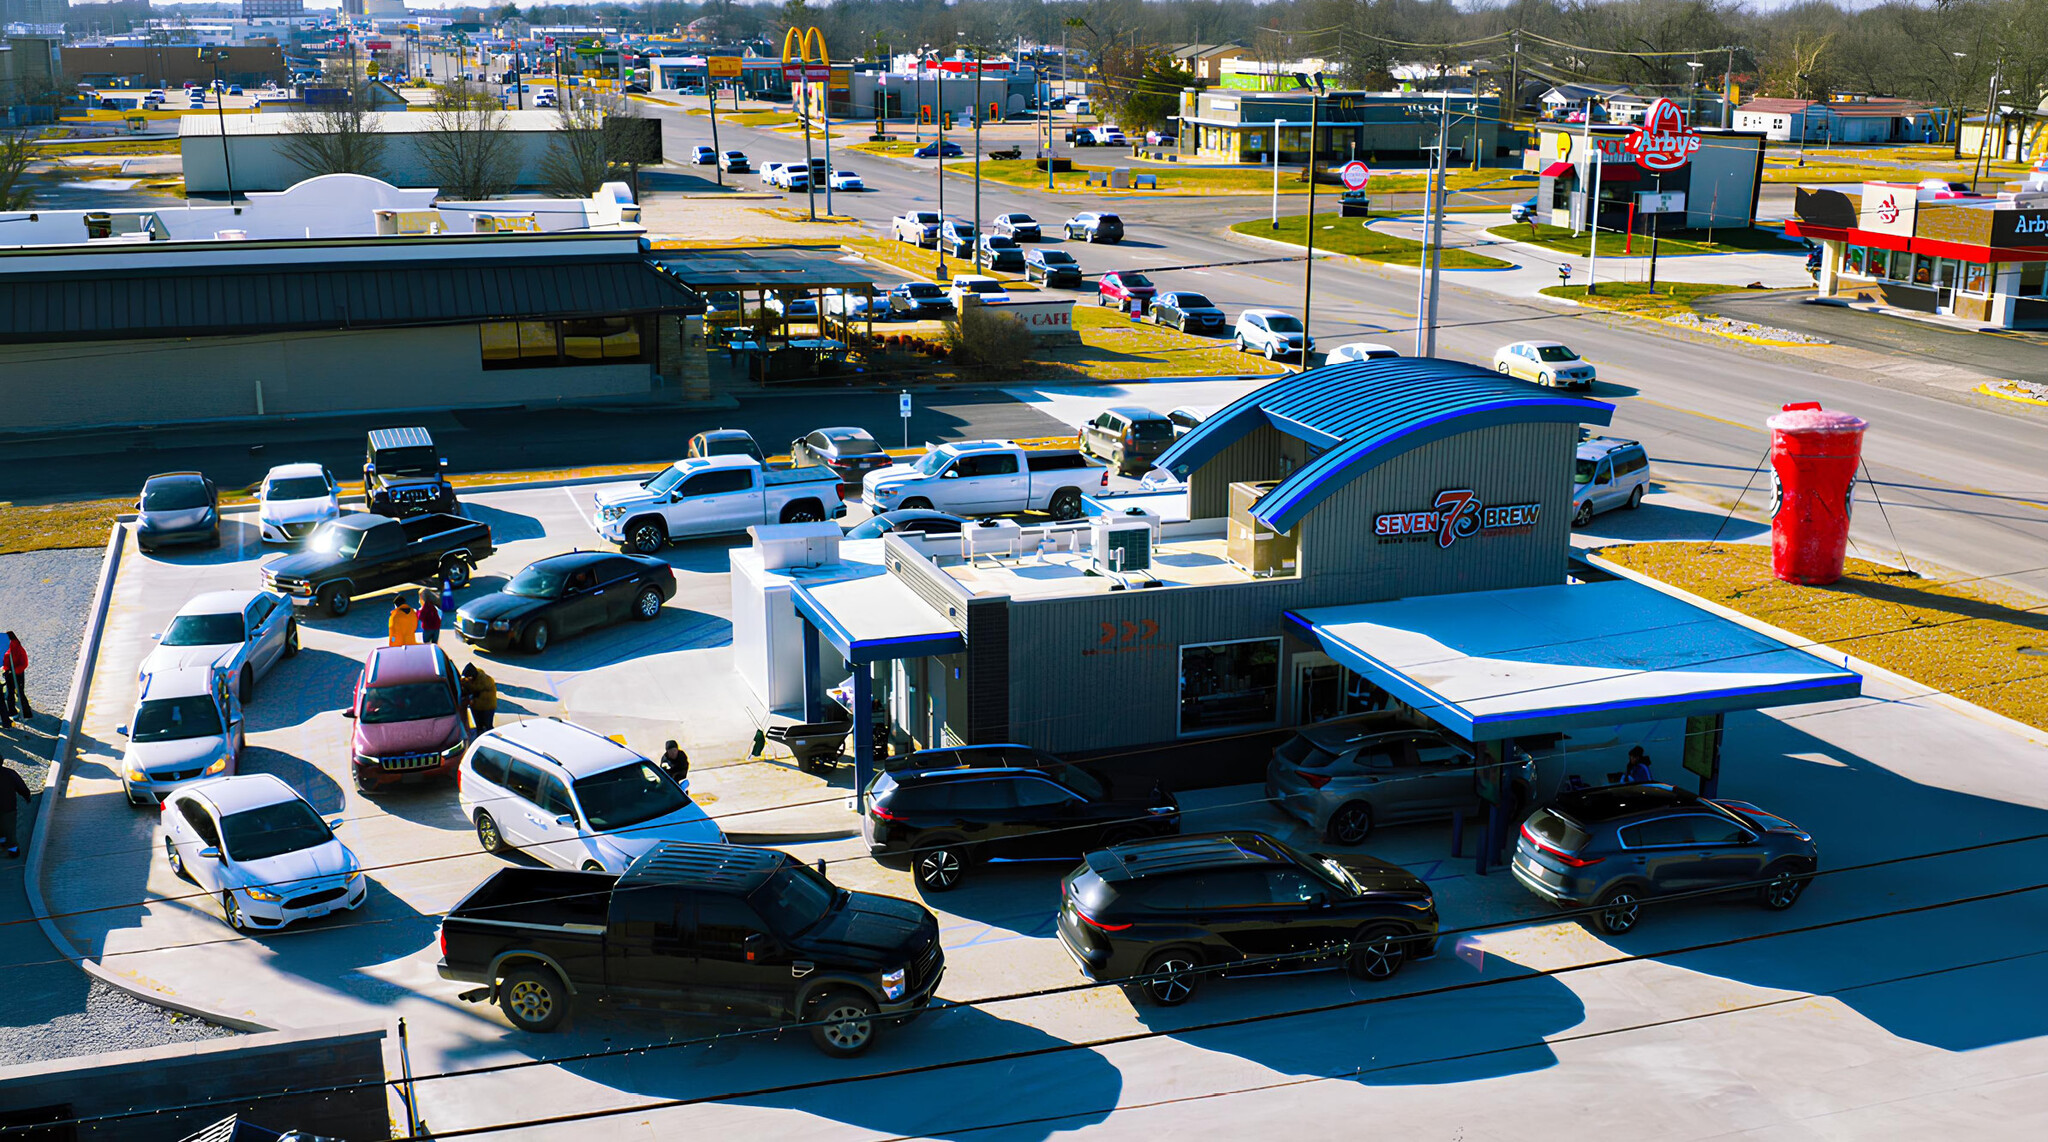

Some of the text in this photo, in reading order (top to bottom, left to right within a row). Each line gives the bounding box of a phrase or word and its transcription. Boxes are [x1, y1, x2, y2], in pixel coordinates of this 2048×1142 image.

[1638, 130, 1700, 157] Arby's
[1032, 312, 1070, 326] CAFE
[1376, 512, 1438, 535] SEVEN
[1485, 504, 1541, 528] BREW
